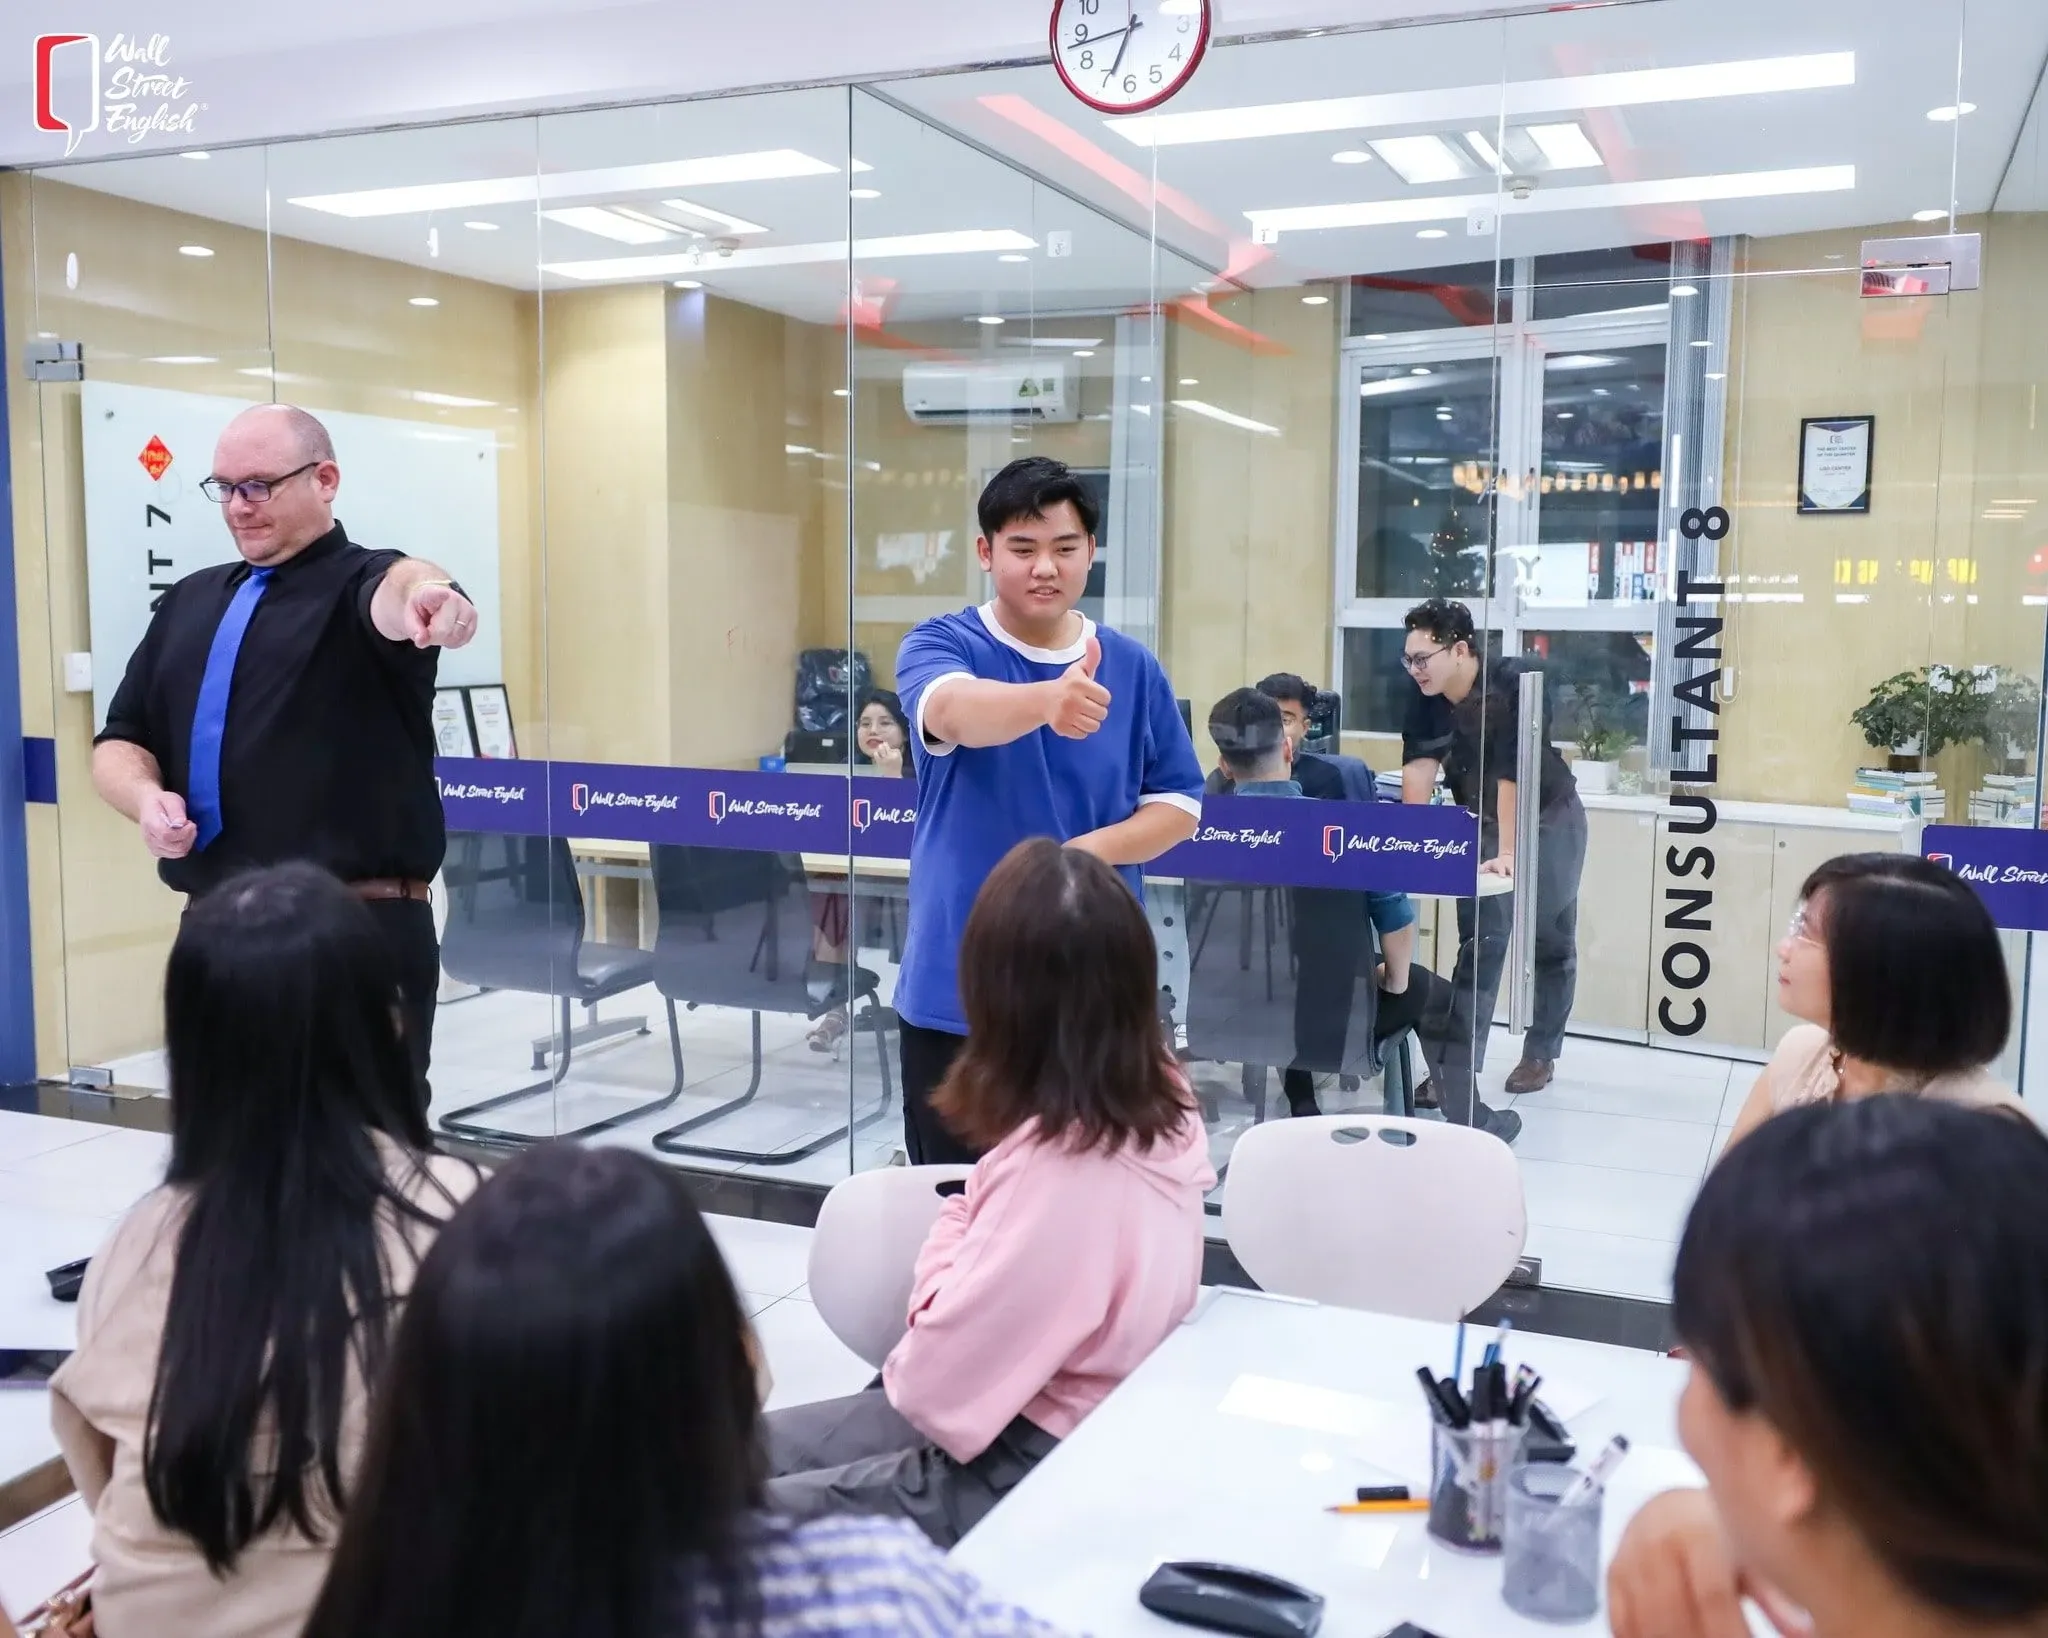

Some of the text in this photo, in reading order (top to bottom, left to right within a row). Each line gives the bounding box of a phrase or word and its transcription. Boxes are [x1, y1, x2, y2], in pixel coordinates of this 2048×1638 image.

[1079, 0, 1099, 15] 10
[1074, 23, 1089, 43] 9
[1176, 15, 1190, 33] 3
[1080, 50, 1094, 70] 8
[1167, 42, 1182, 62] 4
[1101, 69, 1113, 88] 7
[1123, 74, 1137, 93] 6
[1149, 64, 1163, 84] 5
[146, 504, 172, 528] 7
[1658, 505, 1730, 1037] CONSULTANT 8
[443, 783, 524, 804] Wall Street English
[590, 791, 678, 813] Wall Street English
[728, 799, 821, 821] Wall Street English
[873, 807, 900, 824] Wall
[1201, 827, 1239, 842] Street
[1240, 829, 1282, 849] English
[1348, 834, 1469, 859] Wall Street English
[1958, 863, 2048, 884] Wall Street
